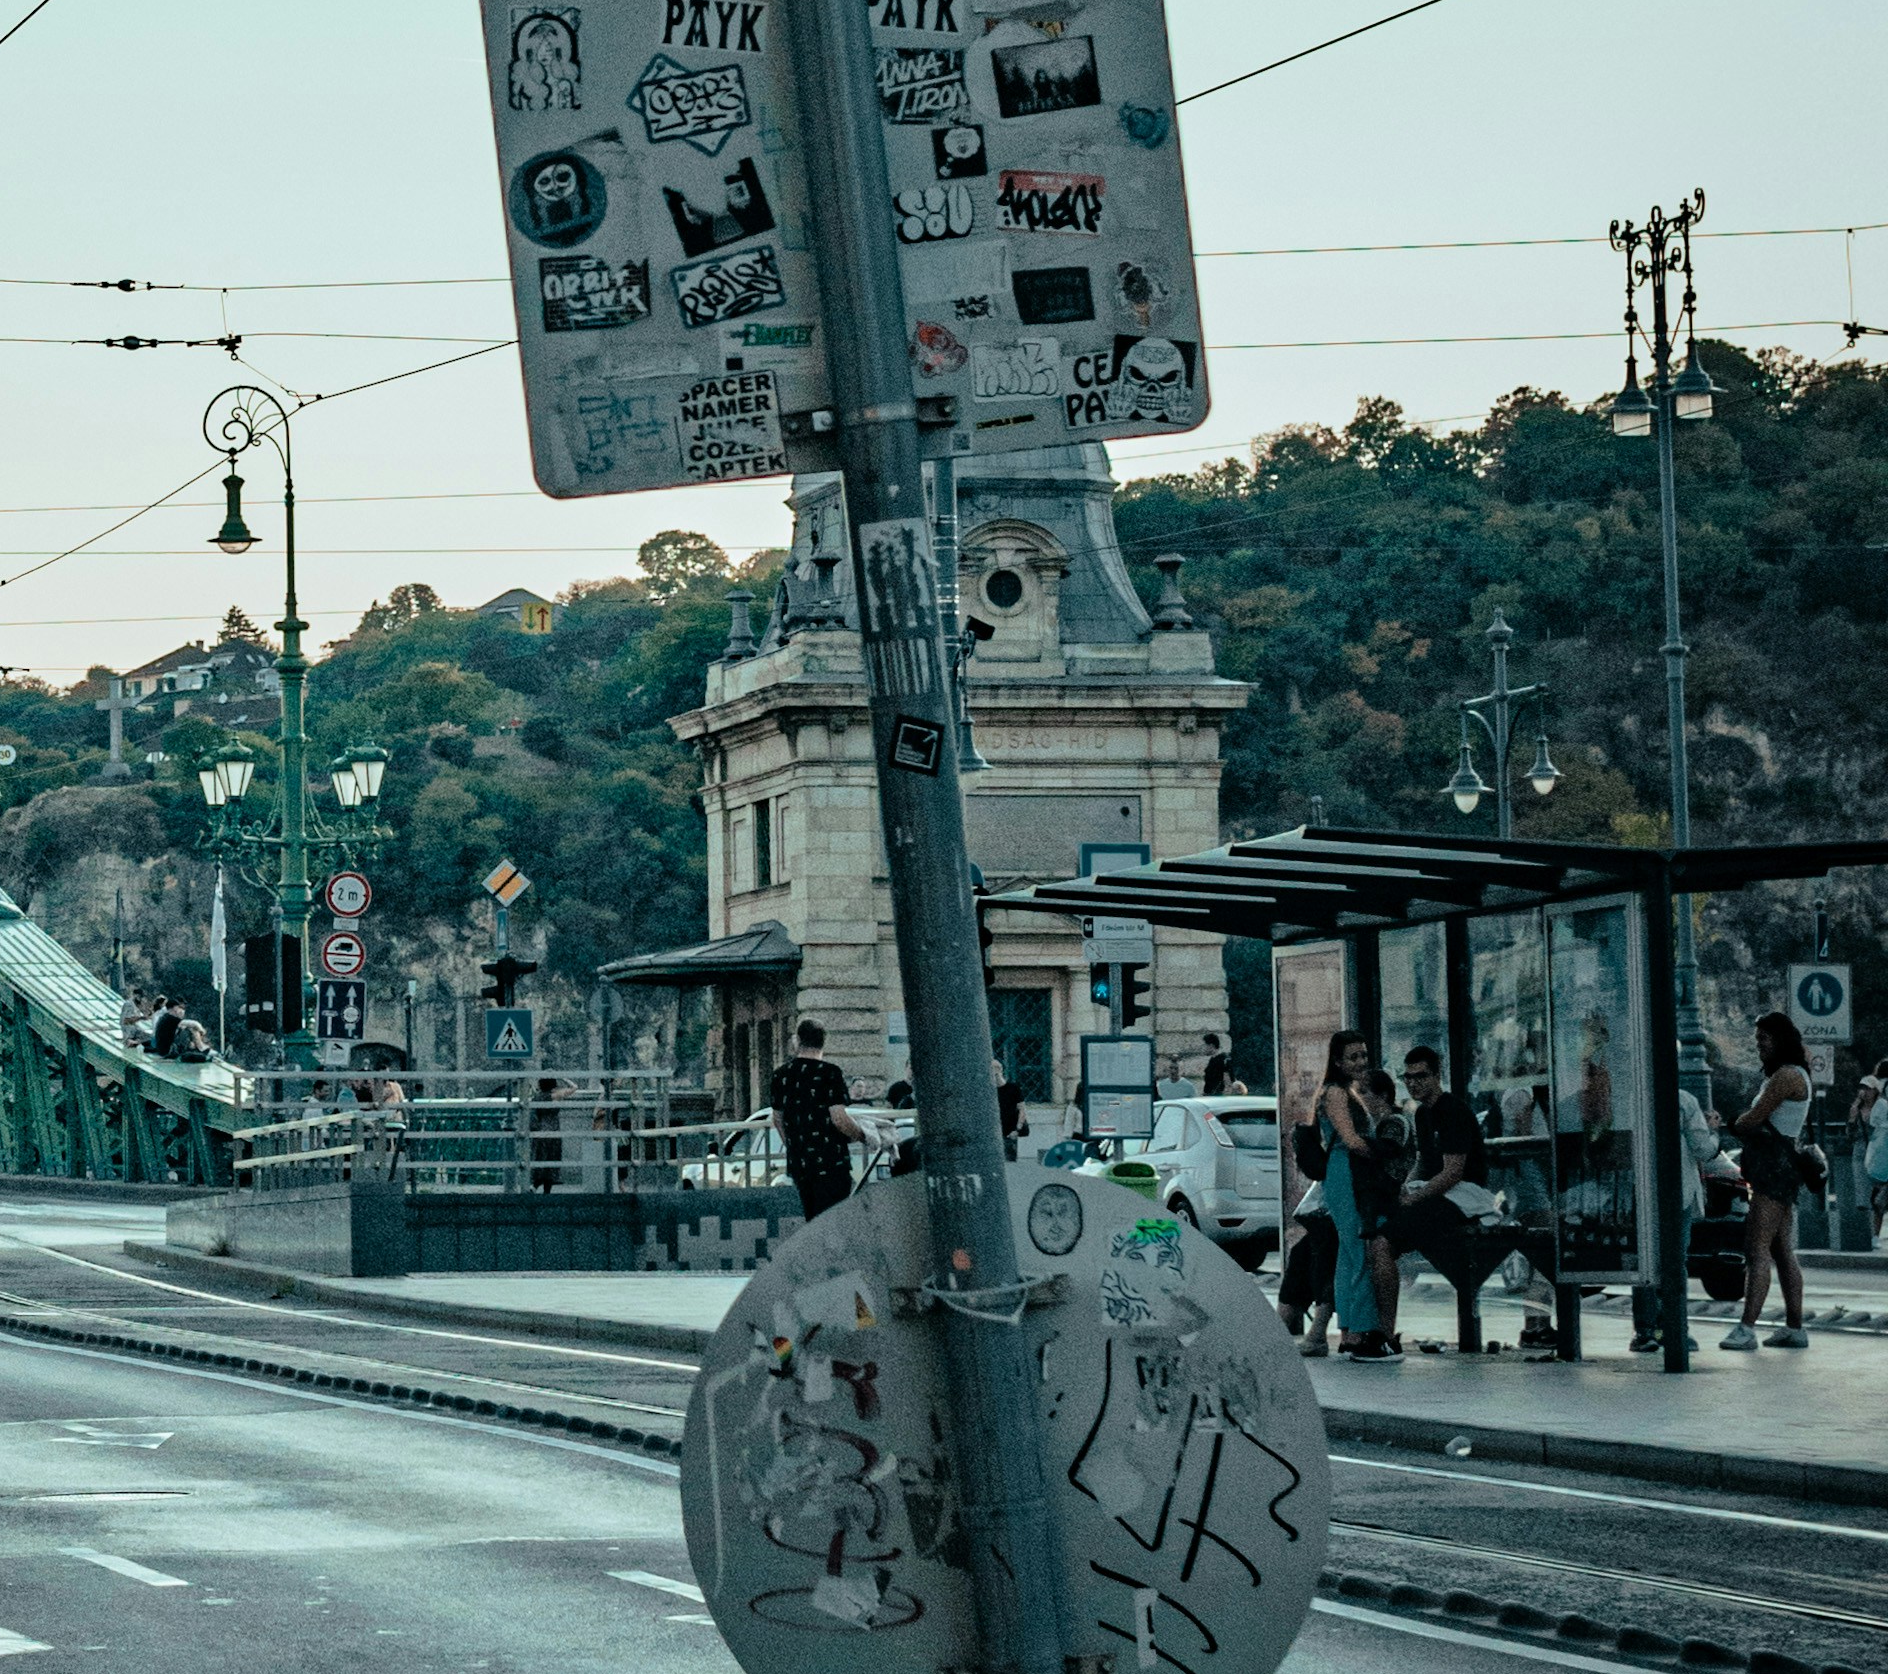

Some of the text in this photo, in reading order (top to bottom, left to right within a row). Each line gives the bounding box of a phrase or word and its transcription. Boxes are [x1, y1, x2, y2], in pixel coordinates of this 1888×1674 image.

[681, 393, 772, 423] NAMER
[689, 440, 765, 462] COZE
[338, 887, 358, 901] 2 m
